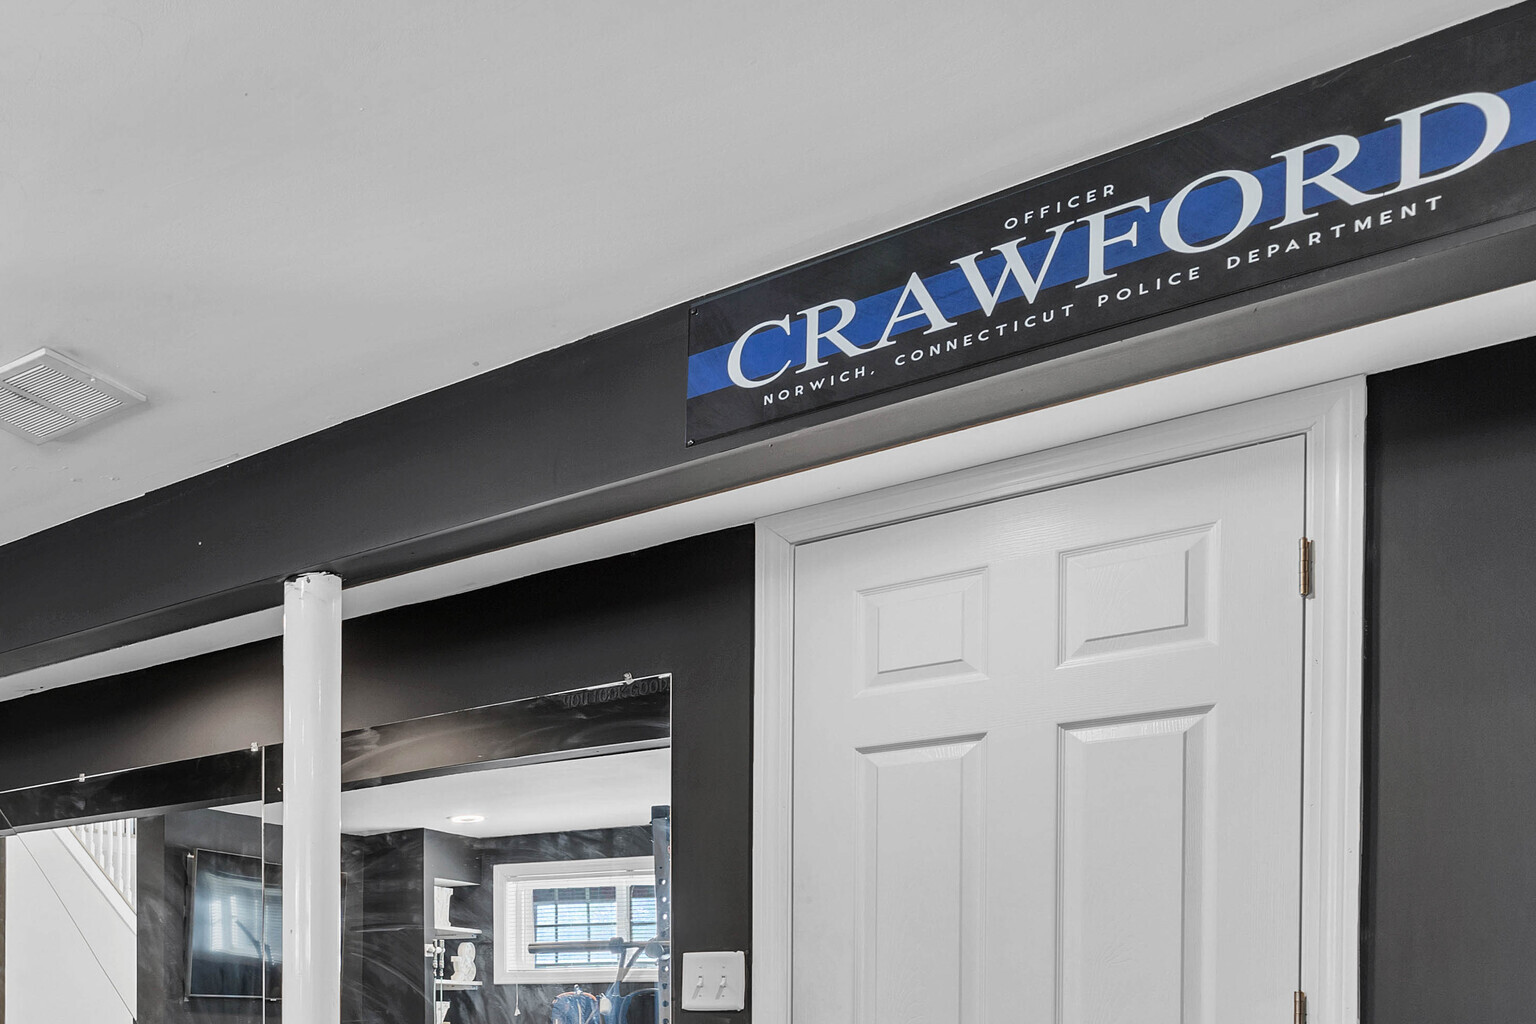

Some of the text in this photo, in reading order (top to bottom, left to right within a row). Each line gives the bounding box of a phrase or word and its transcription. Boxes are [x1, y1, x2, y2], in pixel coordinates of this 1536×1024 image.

[726, 91, 1511, 389] CRAWFORD
[763, 195, 1443, 406] NORWICH, CONNECTICUT POLICE DEPARTMENT
[1003, 184, 1115, 230] OFFICER
